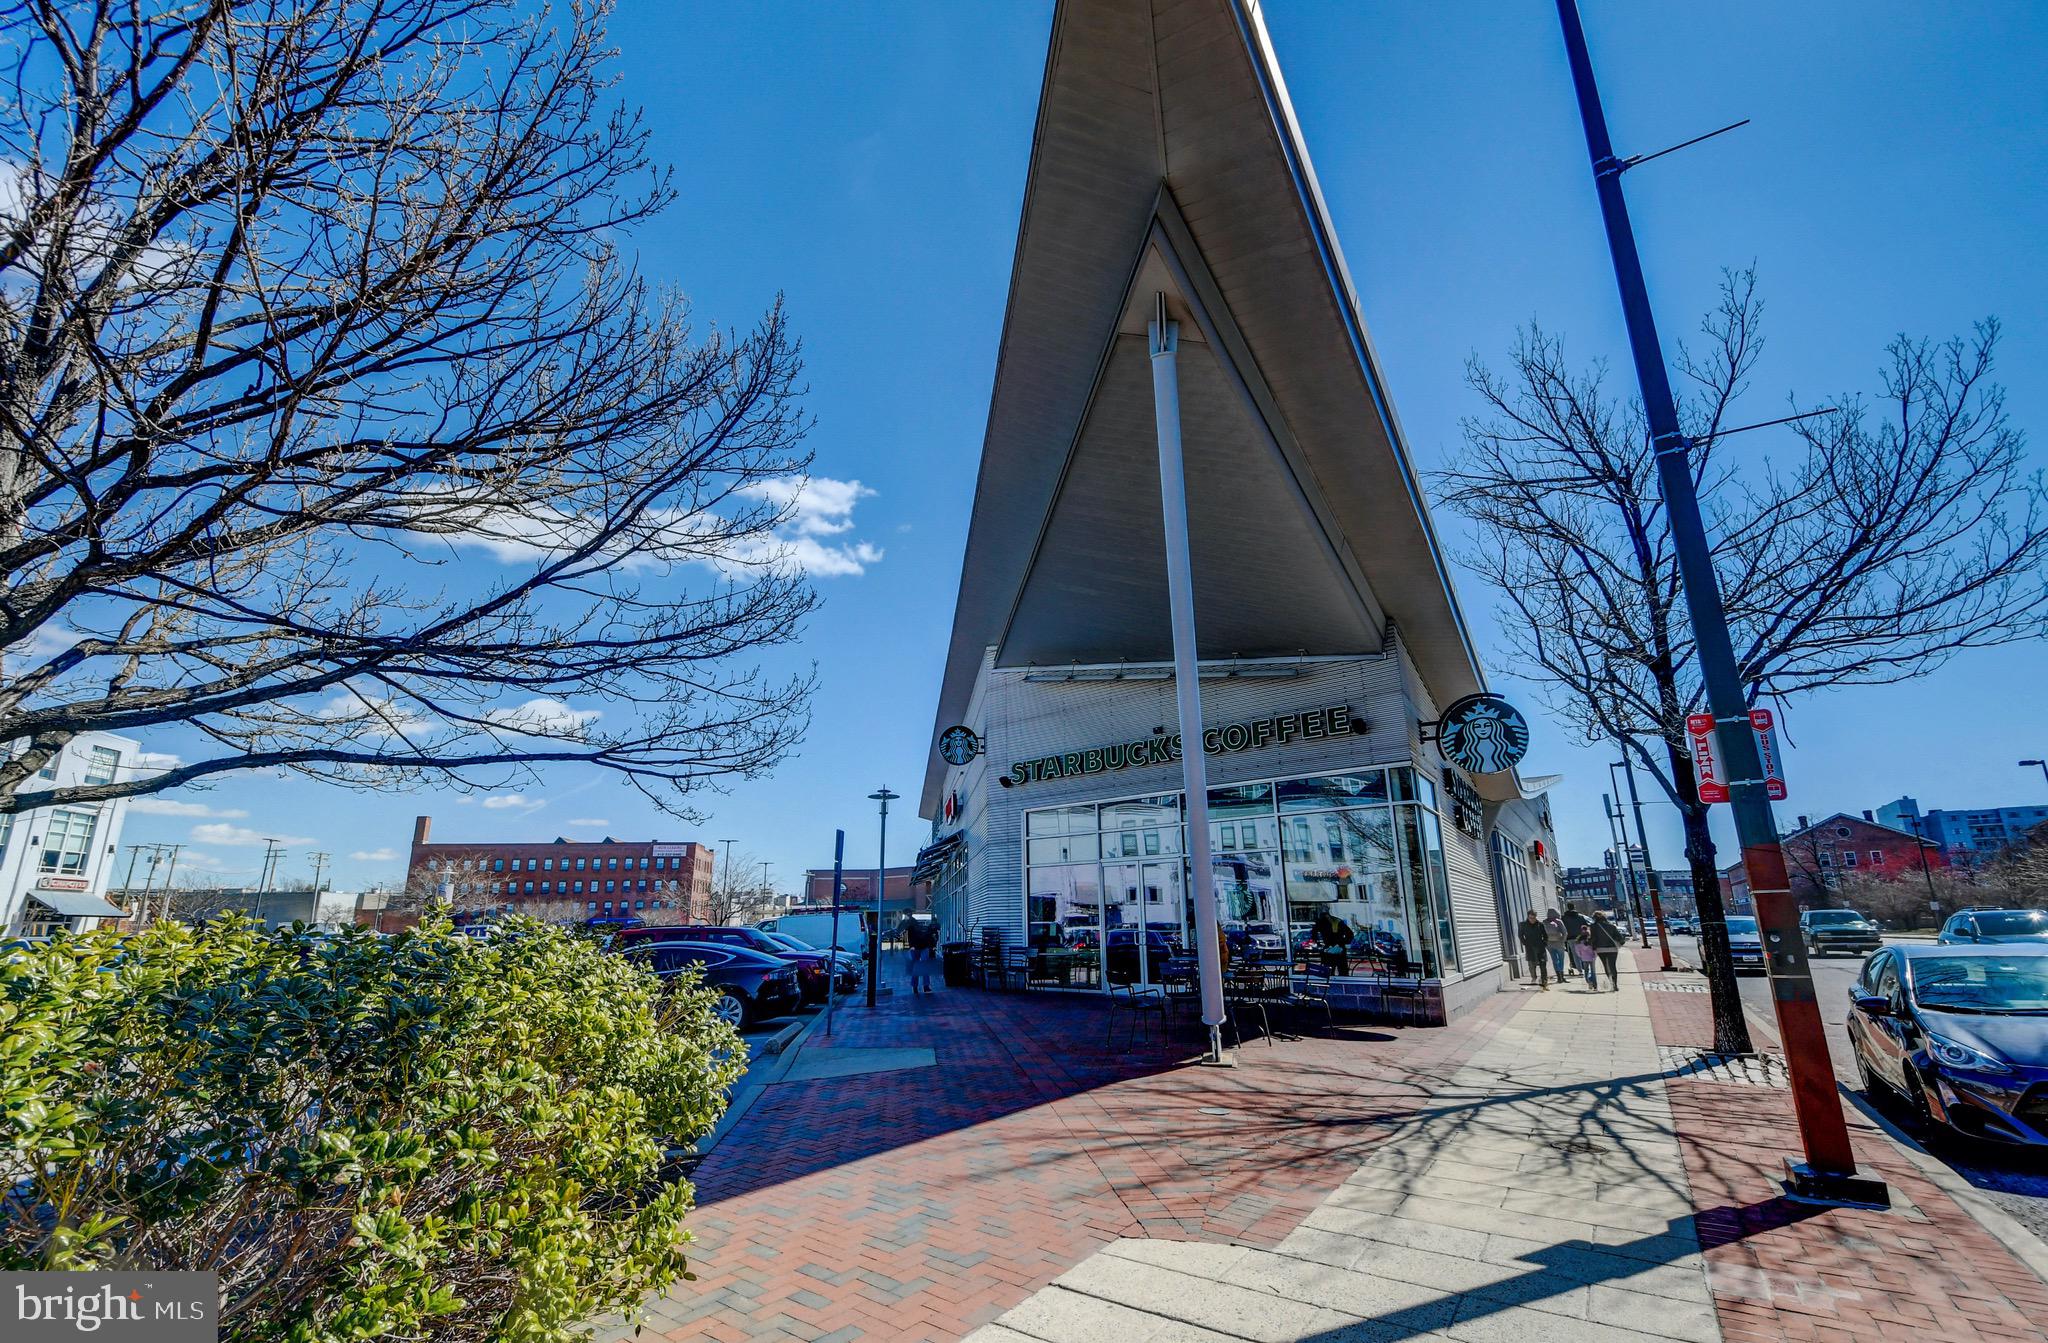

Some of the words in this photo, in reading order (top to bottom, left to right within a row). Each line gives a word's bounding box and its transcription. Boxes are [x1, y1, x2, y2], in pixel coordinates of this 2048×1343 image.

[1011, 733, 1183, 784] STARBUCKS
[1201, 705, 1349, 754] COFFEE
[1763, 752, 1775, 775] STOP
